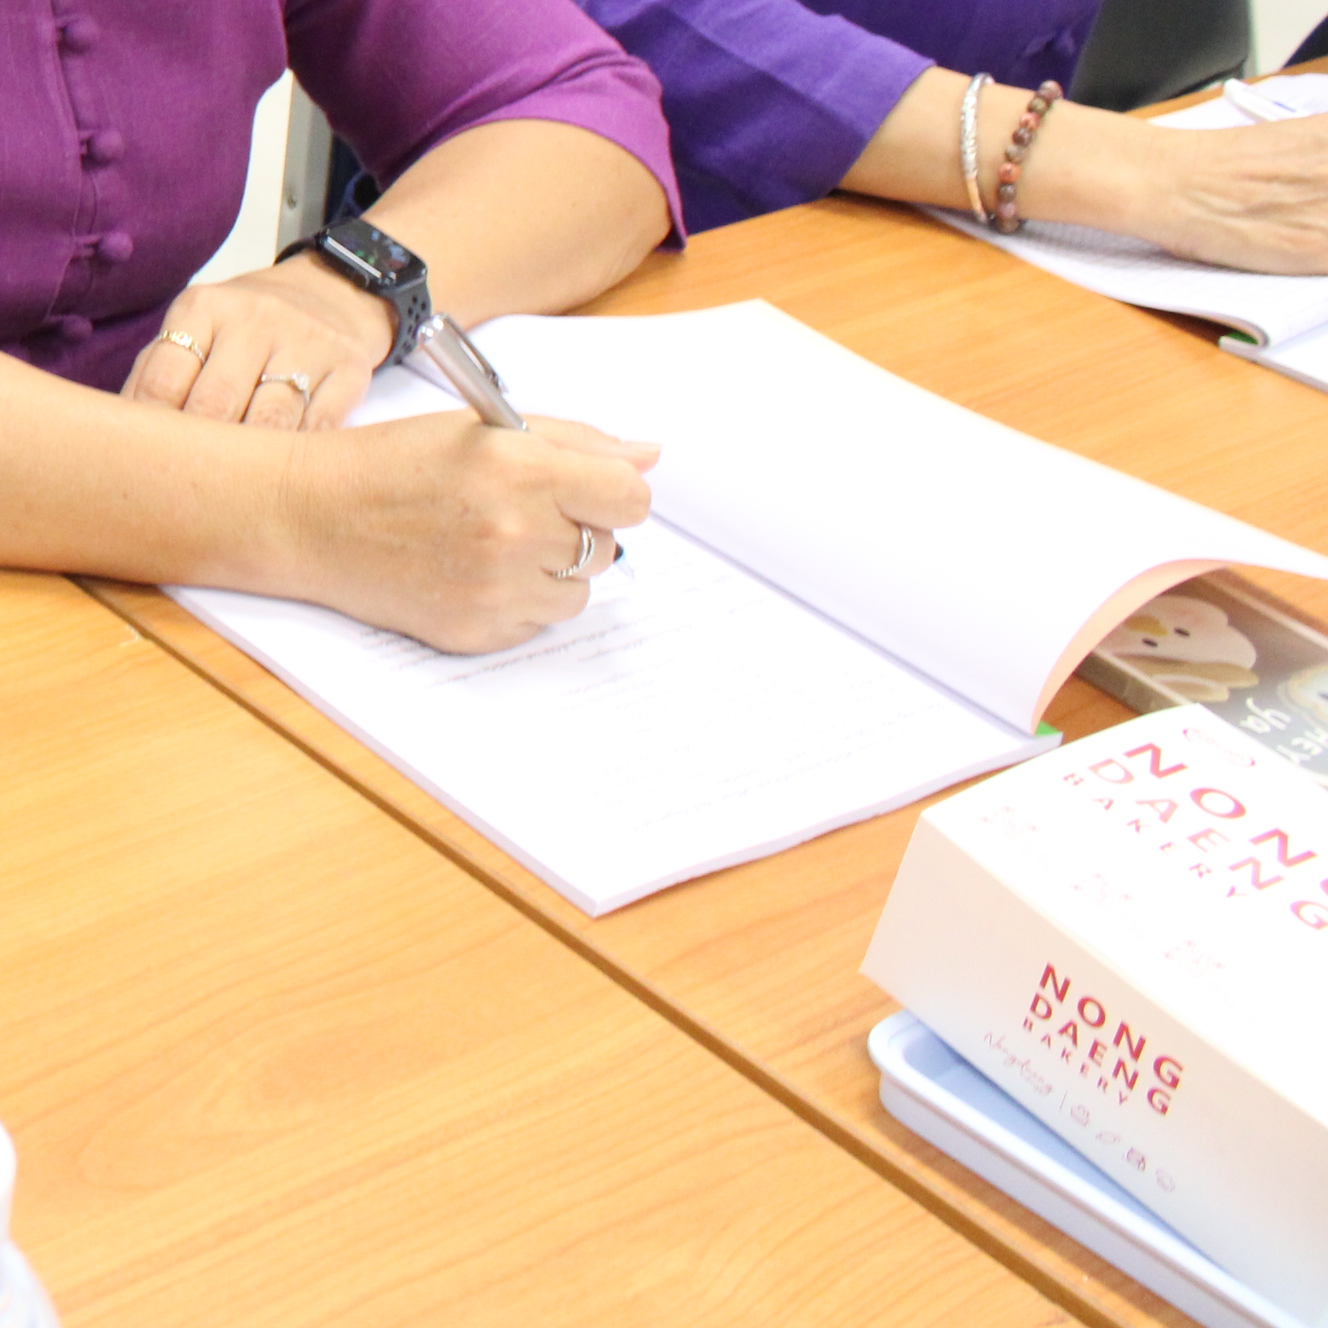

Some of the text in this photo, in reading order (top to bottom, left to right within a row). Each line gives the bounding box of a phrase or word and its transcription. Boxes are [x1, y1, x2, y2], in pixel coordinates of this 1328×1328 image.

[1122, 742, 1328, 898] NON
[1022, 1015, 1129, 1107] BAKERY
[1029, 992, 1173, 1117] DAENG
[1038, 961, 1185, 1091] NONG
